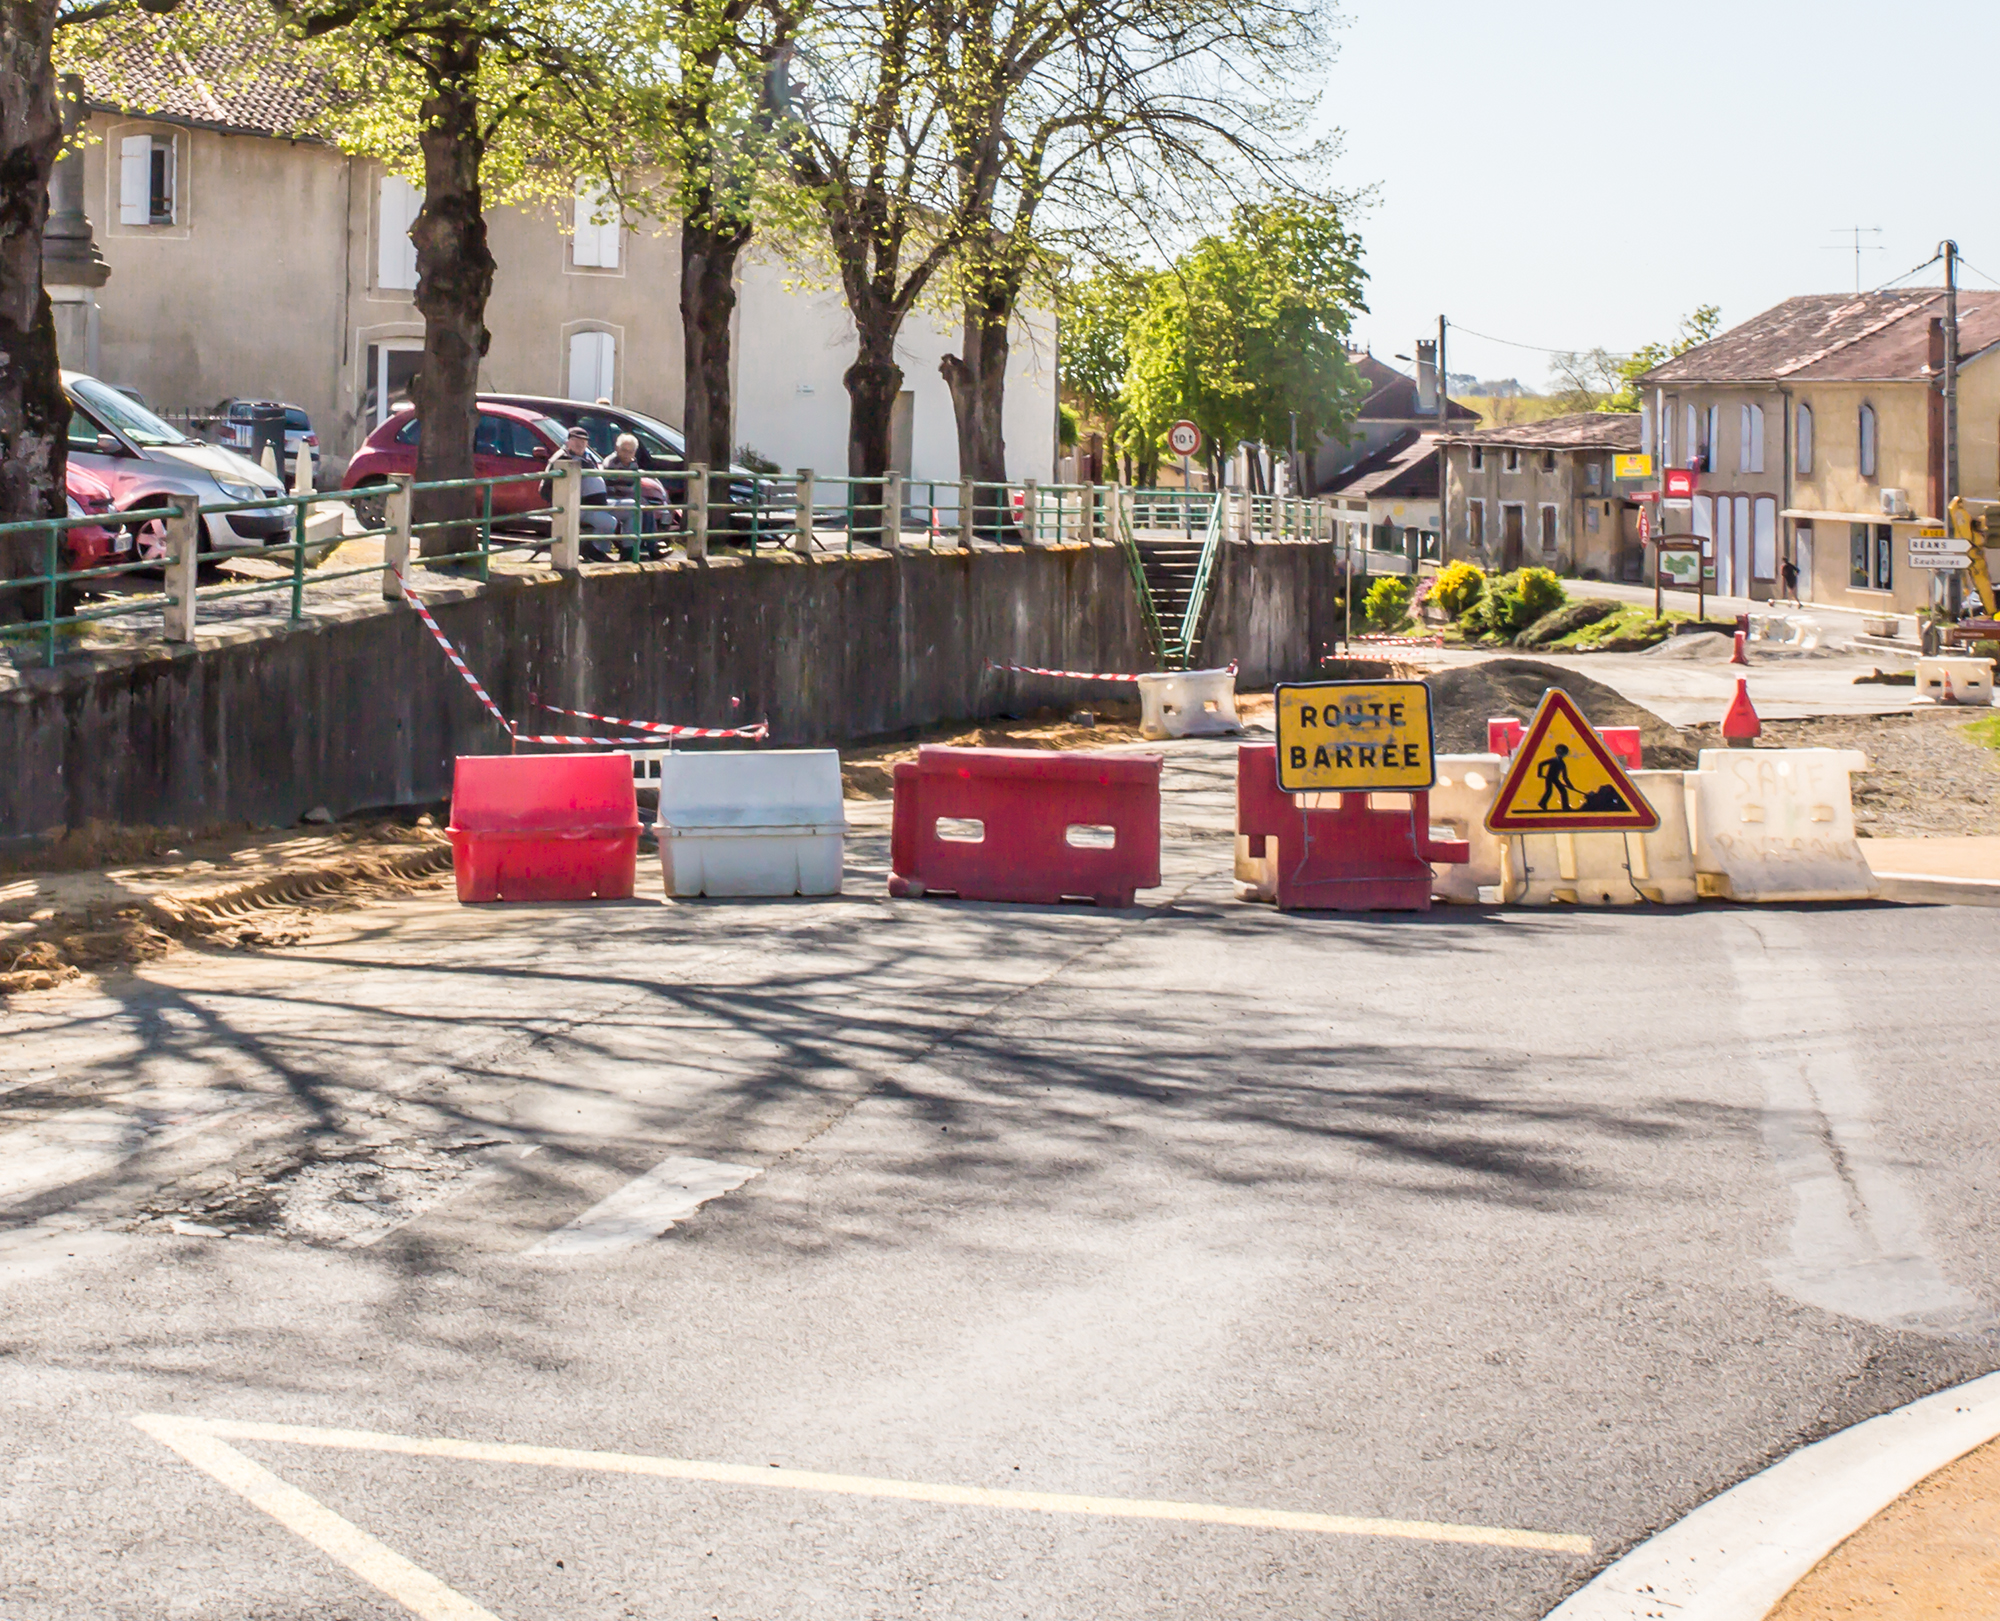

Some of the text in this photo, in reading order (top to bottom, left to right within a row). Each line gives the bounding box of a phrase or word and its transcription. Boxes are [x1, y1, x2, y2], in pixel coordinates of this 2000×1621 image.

[1174, 434, 1186, 444] 10
[1300, 703, 1406, 728] ROUTE
[1731, 756, 1823, 800] SAUF
